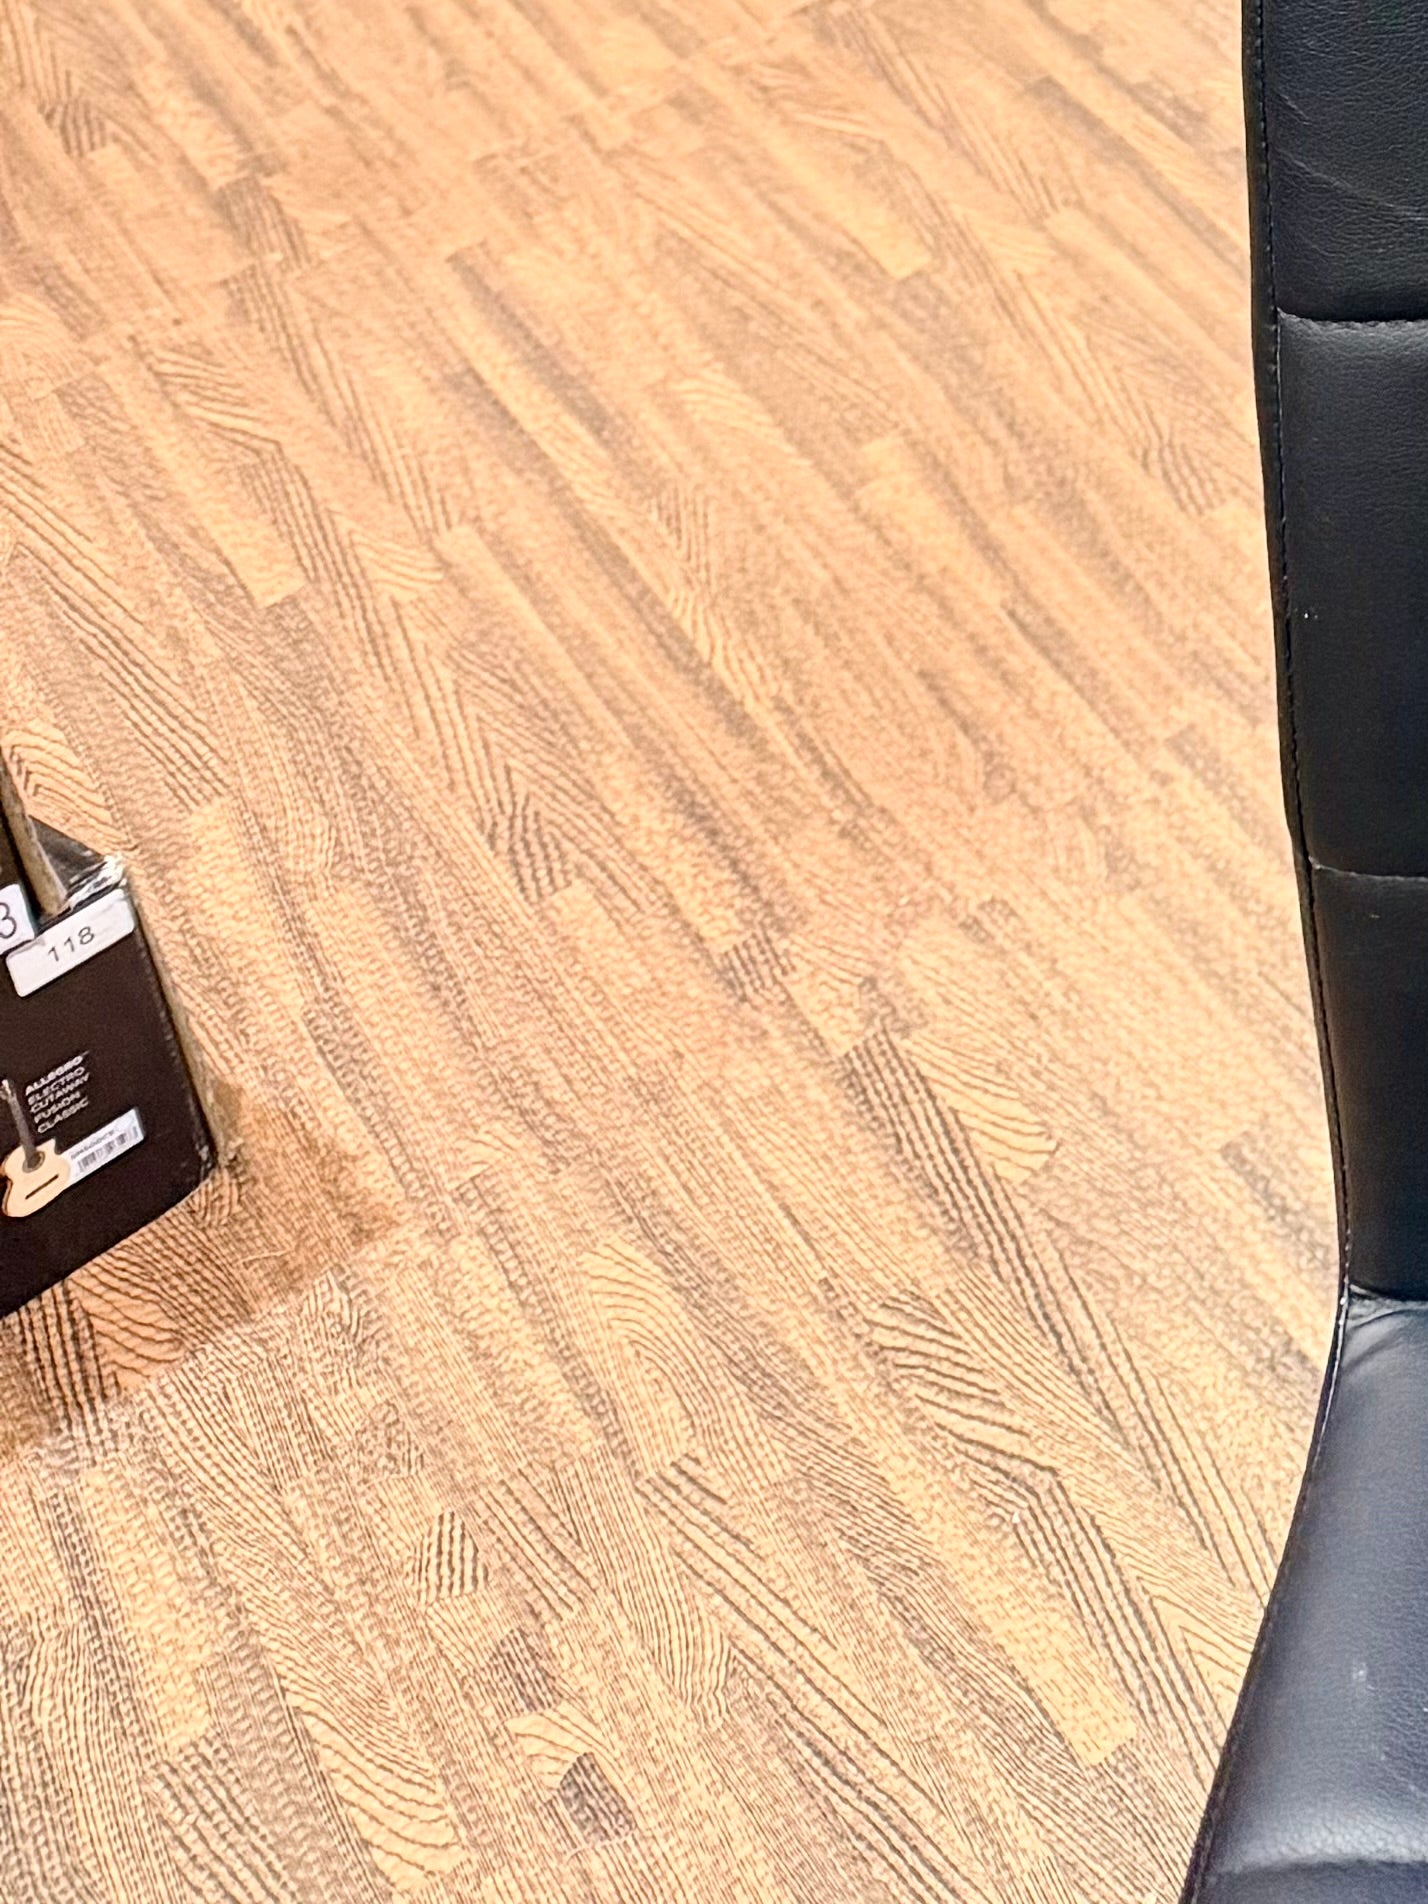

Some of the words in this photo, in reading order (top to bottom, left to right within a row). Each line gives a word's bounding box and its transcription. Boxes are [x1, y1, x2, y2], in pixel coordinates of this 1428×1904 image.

[48, 926, 96, 962] 118
[26, 1055, 84, 1095] ALLEGRO
[27, 1066, 86, 1106] ELECTRO
[30, 1072, 91, 1113] CUTAWAY
[34, 1090, 81, 1123] FUSION
[37, 1096, 90, 1134] CLASSIC
